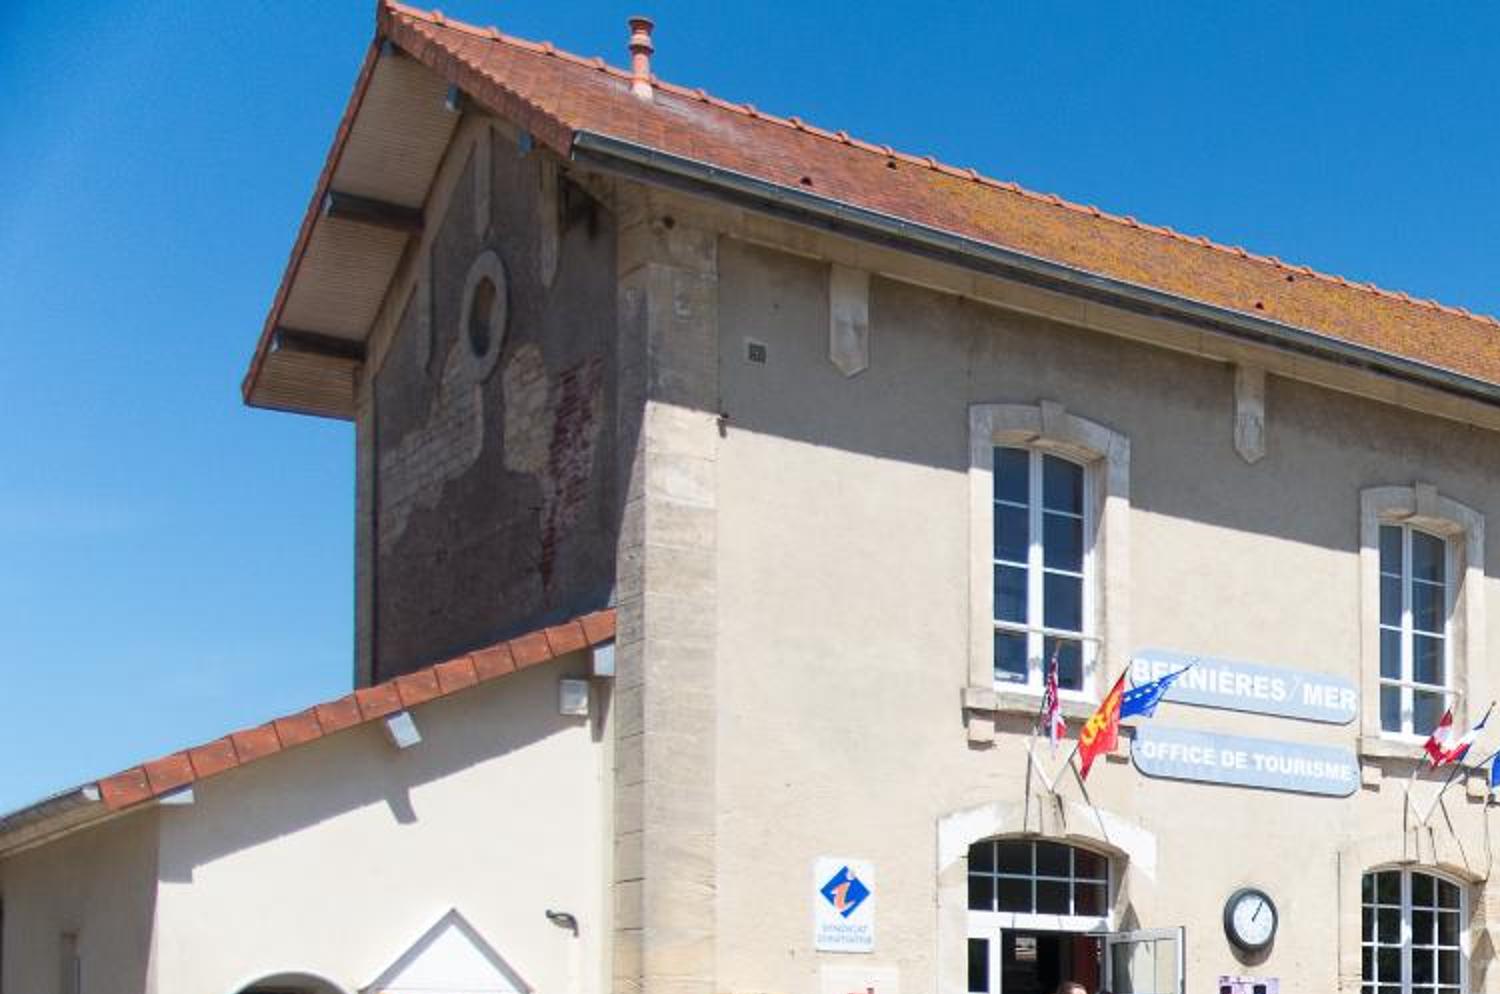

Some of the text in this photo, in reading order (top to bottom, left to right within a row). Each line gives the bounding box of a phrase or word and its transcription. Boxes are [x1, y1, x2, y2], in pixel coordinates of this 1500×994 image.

[1141, 741, 1354, 781] OFFICE DE TOURISME
